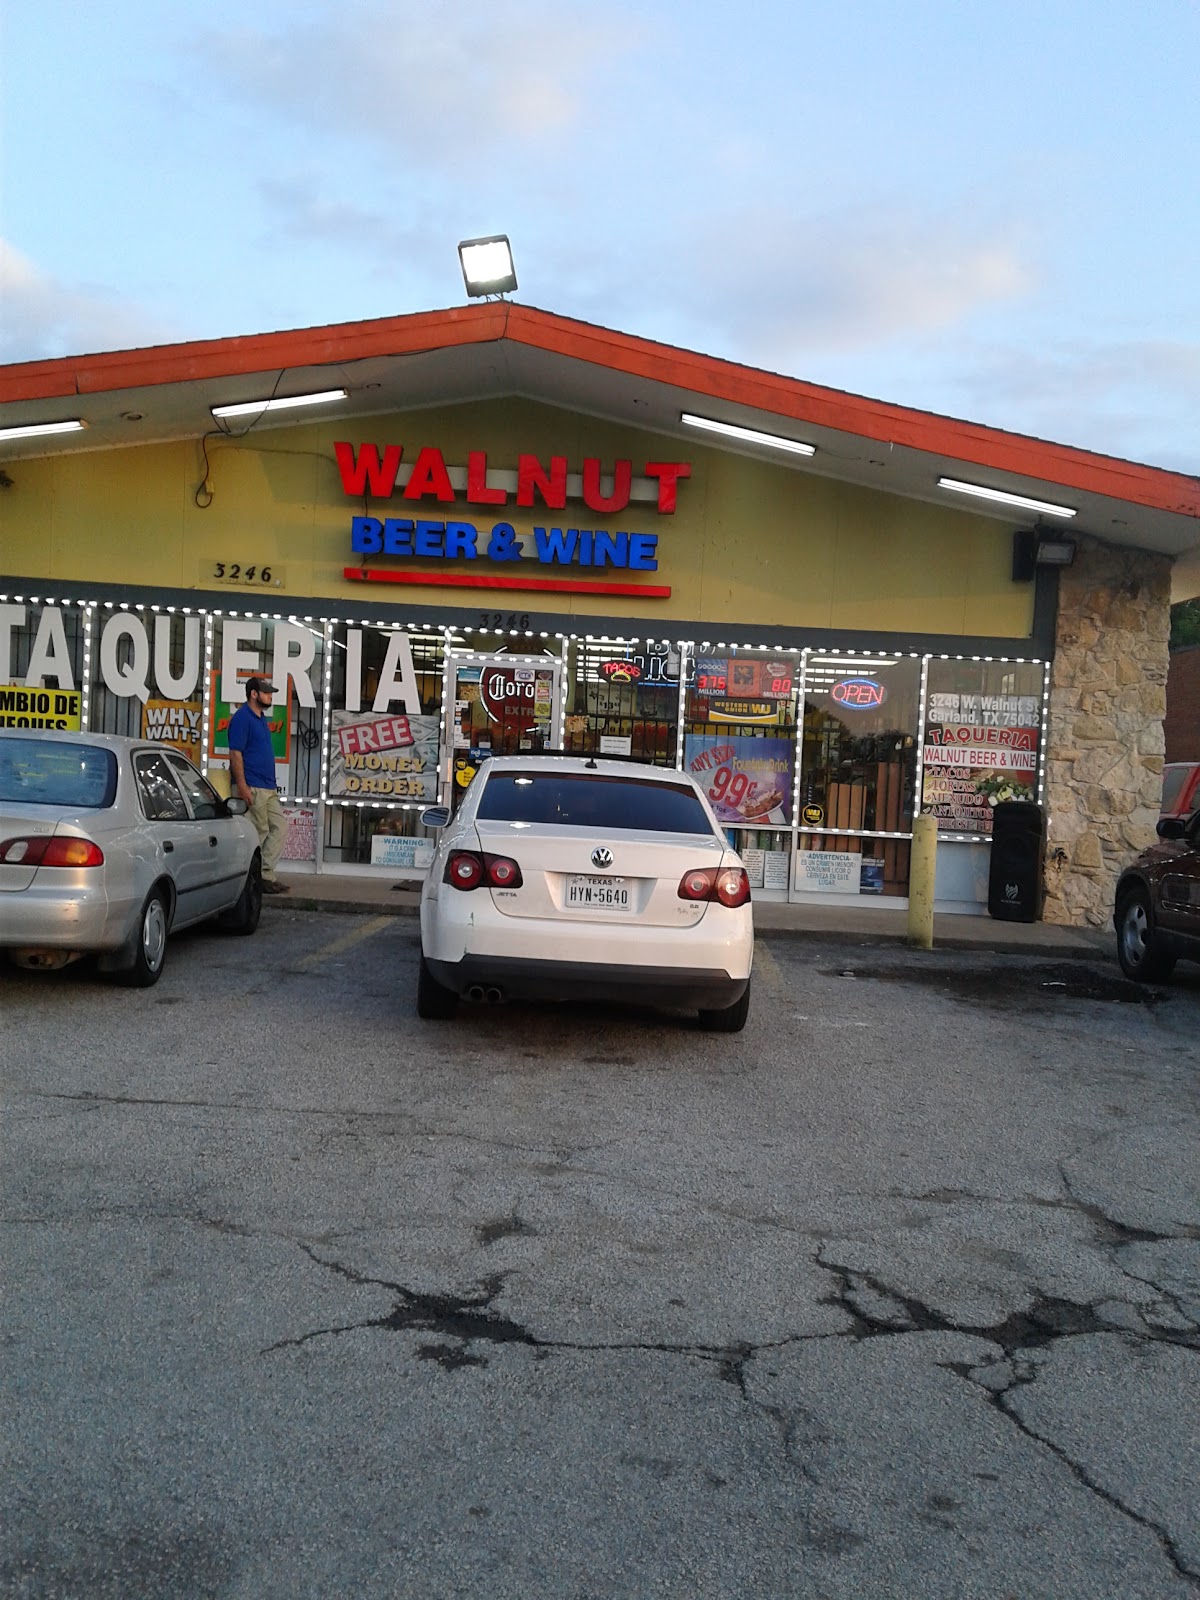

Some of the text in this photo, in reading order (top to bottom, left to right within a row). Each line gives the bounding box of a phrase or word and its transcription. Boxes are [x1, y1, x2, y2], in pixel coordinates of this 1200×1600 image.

[334, 441, 692, 515] WALNUT
[352, 516, 658, 571] BEER & WINE
[213, 562, 271, 582] 3246
[479, 613, 529, 629] 3246
[602, 662, 641, 677] TACOS
[489, 673, 535, 700] Coro
[697, 675, 726, 689] 375
[771, 679, 791, 692] 80
[832, 684, 884, 704] OPEN
[929, 694, 959, 708] 3246
[980, 697, 1021, 711] Walnut
[0, 691, 78, 716] MBIO DE
[504, 705, 535, 716] EXTR
[147, 707, 201, 727] WHY
[928, 709, 1039, 727] Garland, TX 75042
[146, 725, 200, 743] WAIT?
[340, 719, 410, 754] FREE
[929, 727, 1032, 750] TAQUERIA
[345, 754, 426, 773] MONEY
[690, 752, 713, 772] ANY
[925, 747, 1036, 769] WALNUT BEER & WINE
[934, 765, 971, 780] TACOS
[345, 777, 424, 796] ORDER
[934, 779, 976, 792] TORTAS
[932, 792, 984, 805] MENUDO
[931, 804, 994, 819] ANTOJITOS
[937, 817, 975, 830] HEESE
[588, 878, 613, 886] TEXAS
[570, 886, 628, 904] HYN 5640
